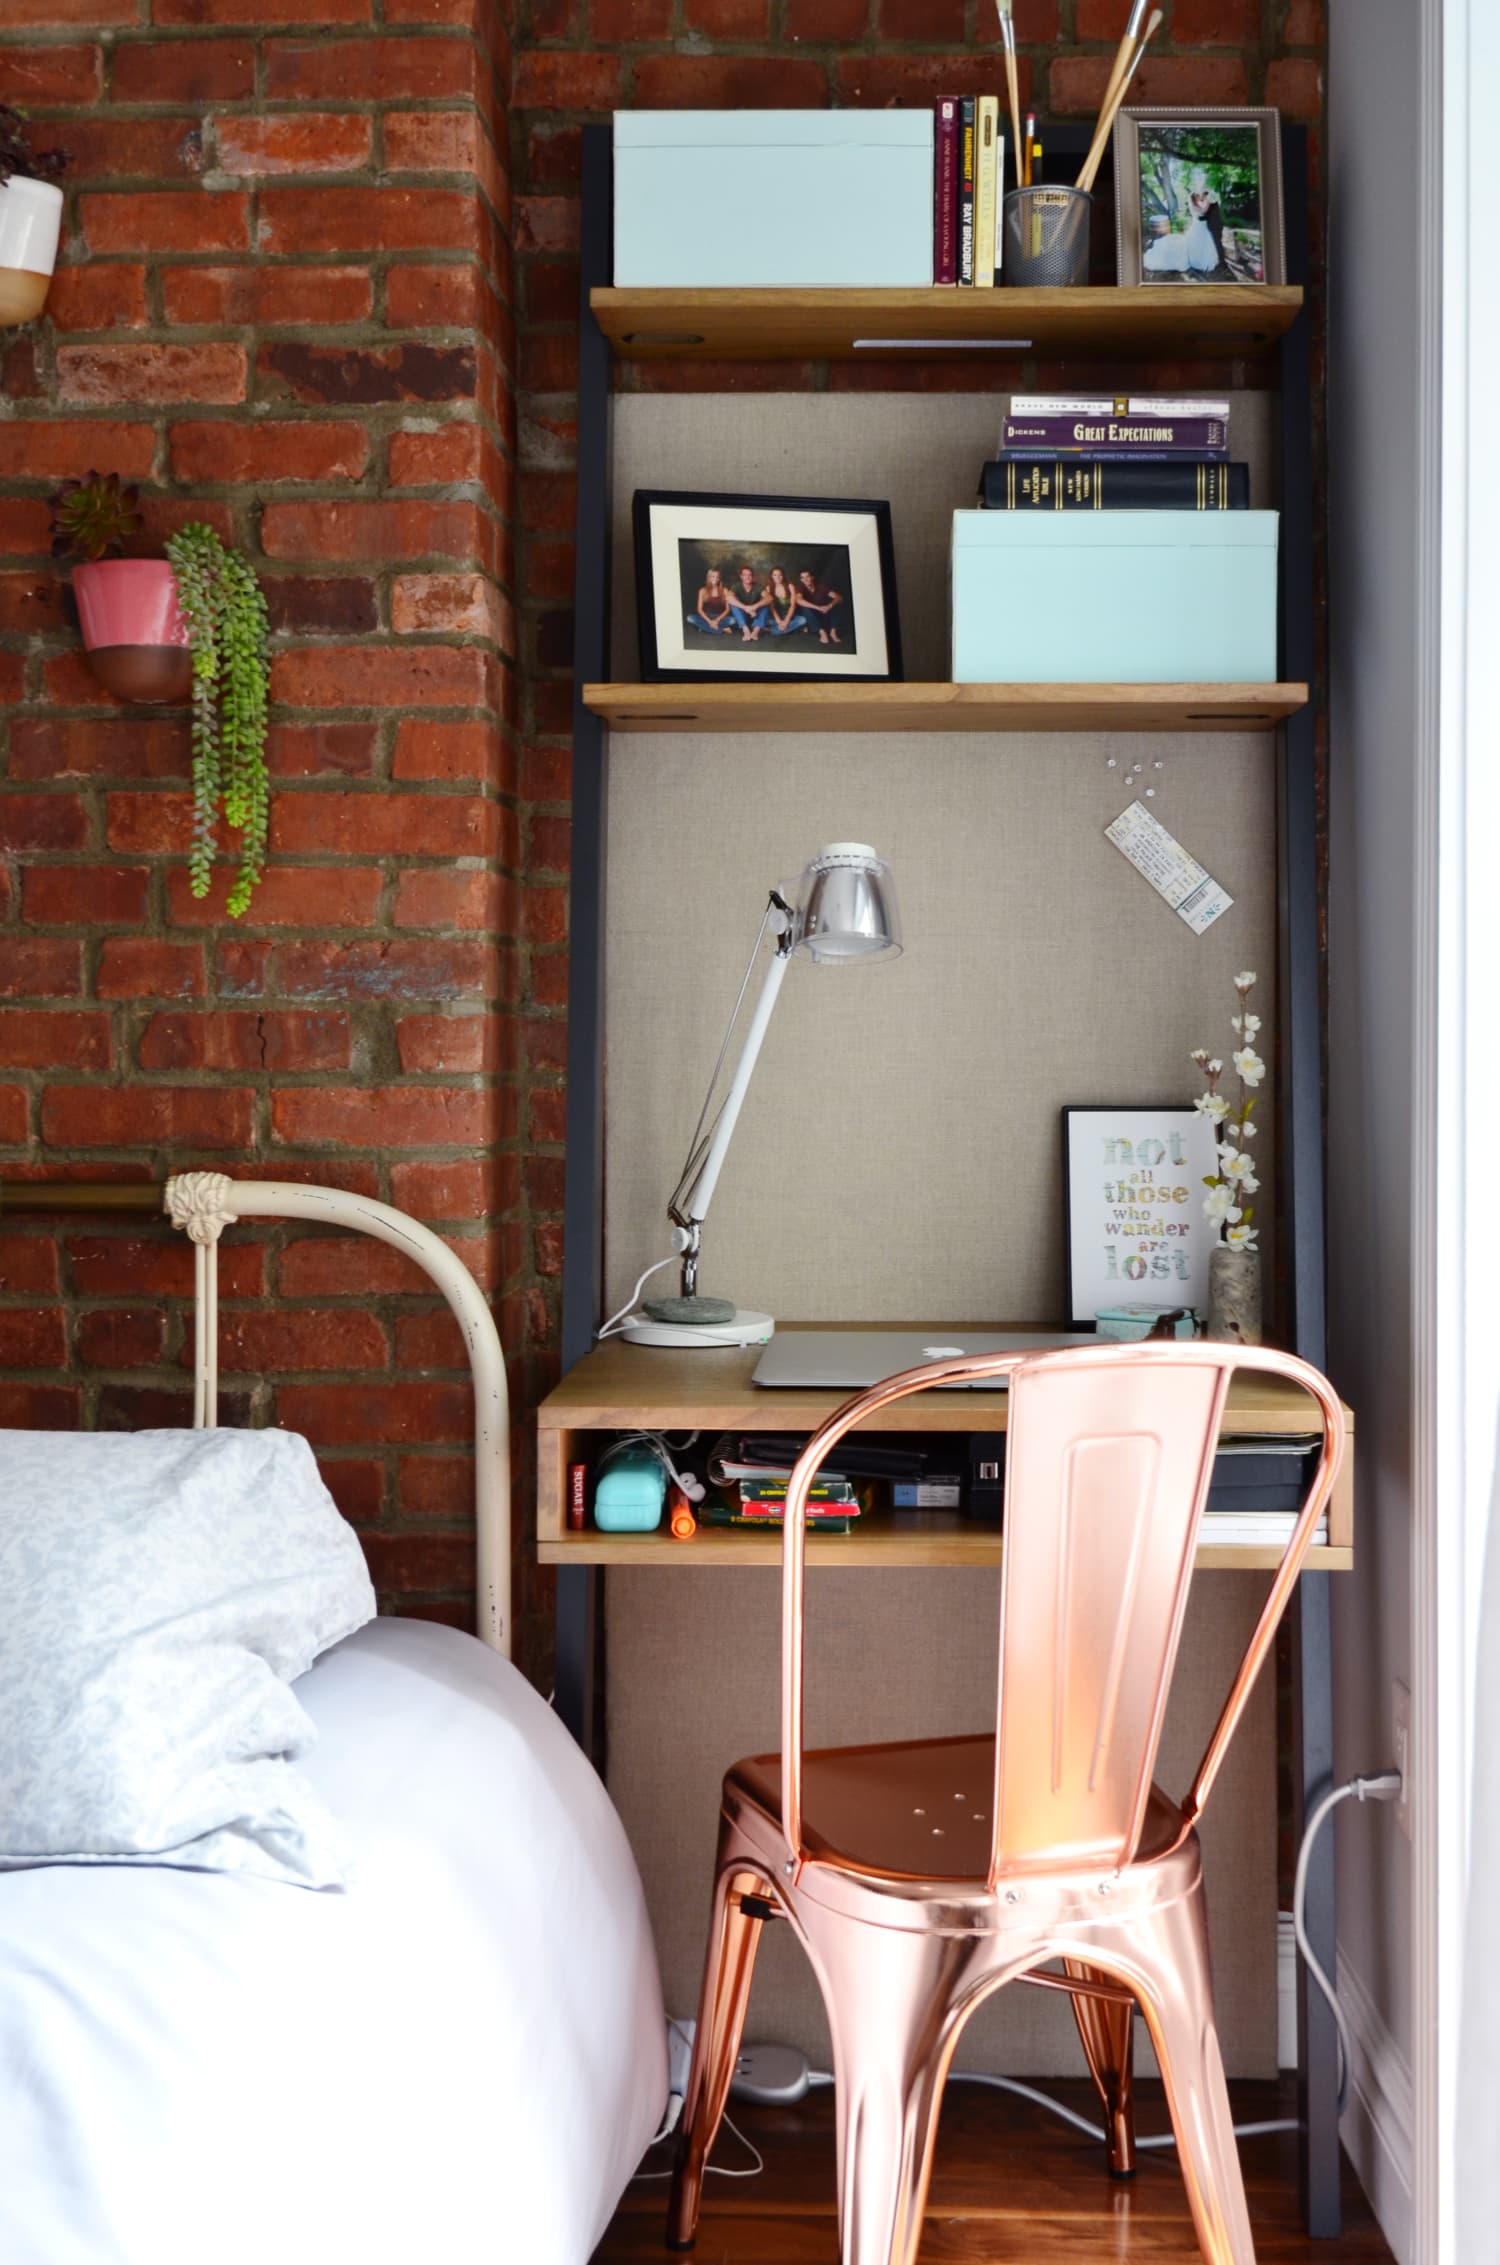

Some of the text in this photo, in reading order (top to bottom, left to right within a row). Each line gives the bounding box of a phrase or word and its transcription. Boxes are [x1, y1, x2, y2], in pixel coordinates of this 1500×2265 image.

[964, 127, 973, 180] FAHRENHEIT
[962, 202, 973, 224] RAY
[962, 225, 972, 281] BRADBURY
[1008, 426, 1046, 438] DICKENS
[1073, 424, 1174, 442] GREAT EXPECTATIONS
[1022, 478, 1030, 493] LIFE
[1032, 466, 1040, 504] APPLICATION
[1102, 1131, 1187, 1166] not
[1130, 1169, 1153, 1184] all
[1104, 1180, 1190, 1204] those
[1112, 1206, 1151, 1220] who
[1105, 1218, 1190, 1237] wander
[1138, 1240, 1169, 1253] are
[1104, 1244, 1191, 1280] lost
[573, 1471, 584, 1505] SUGAR
